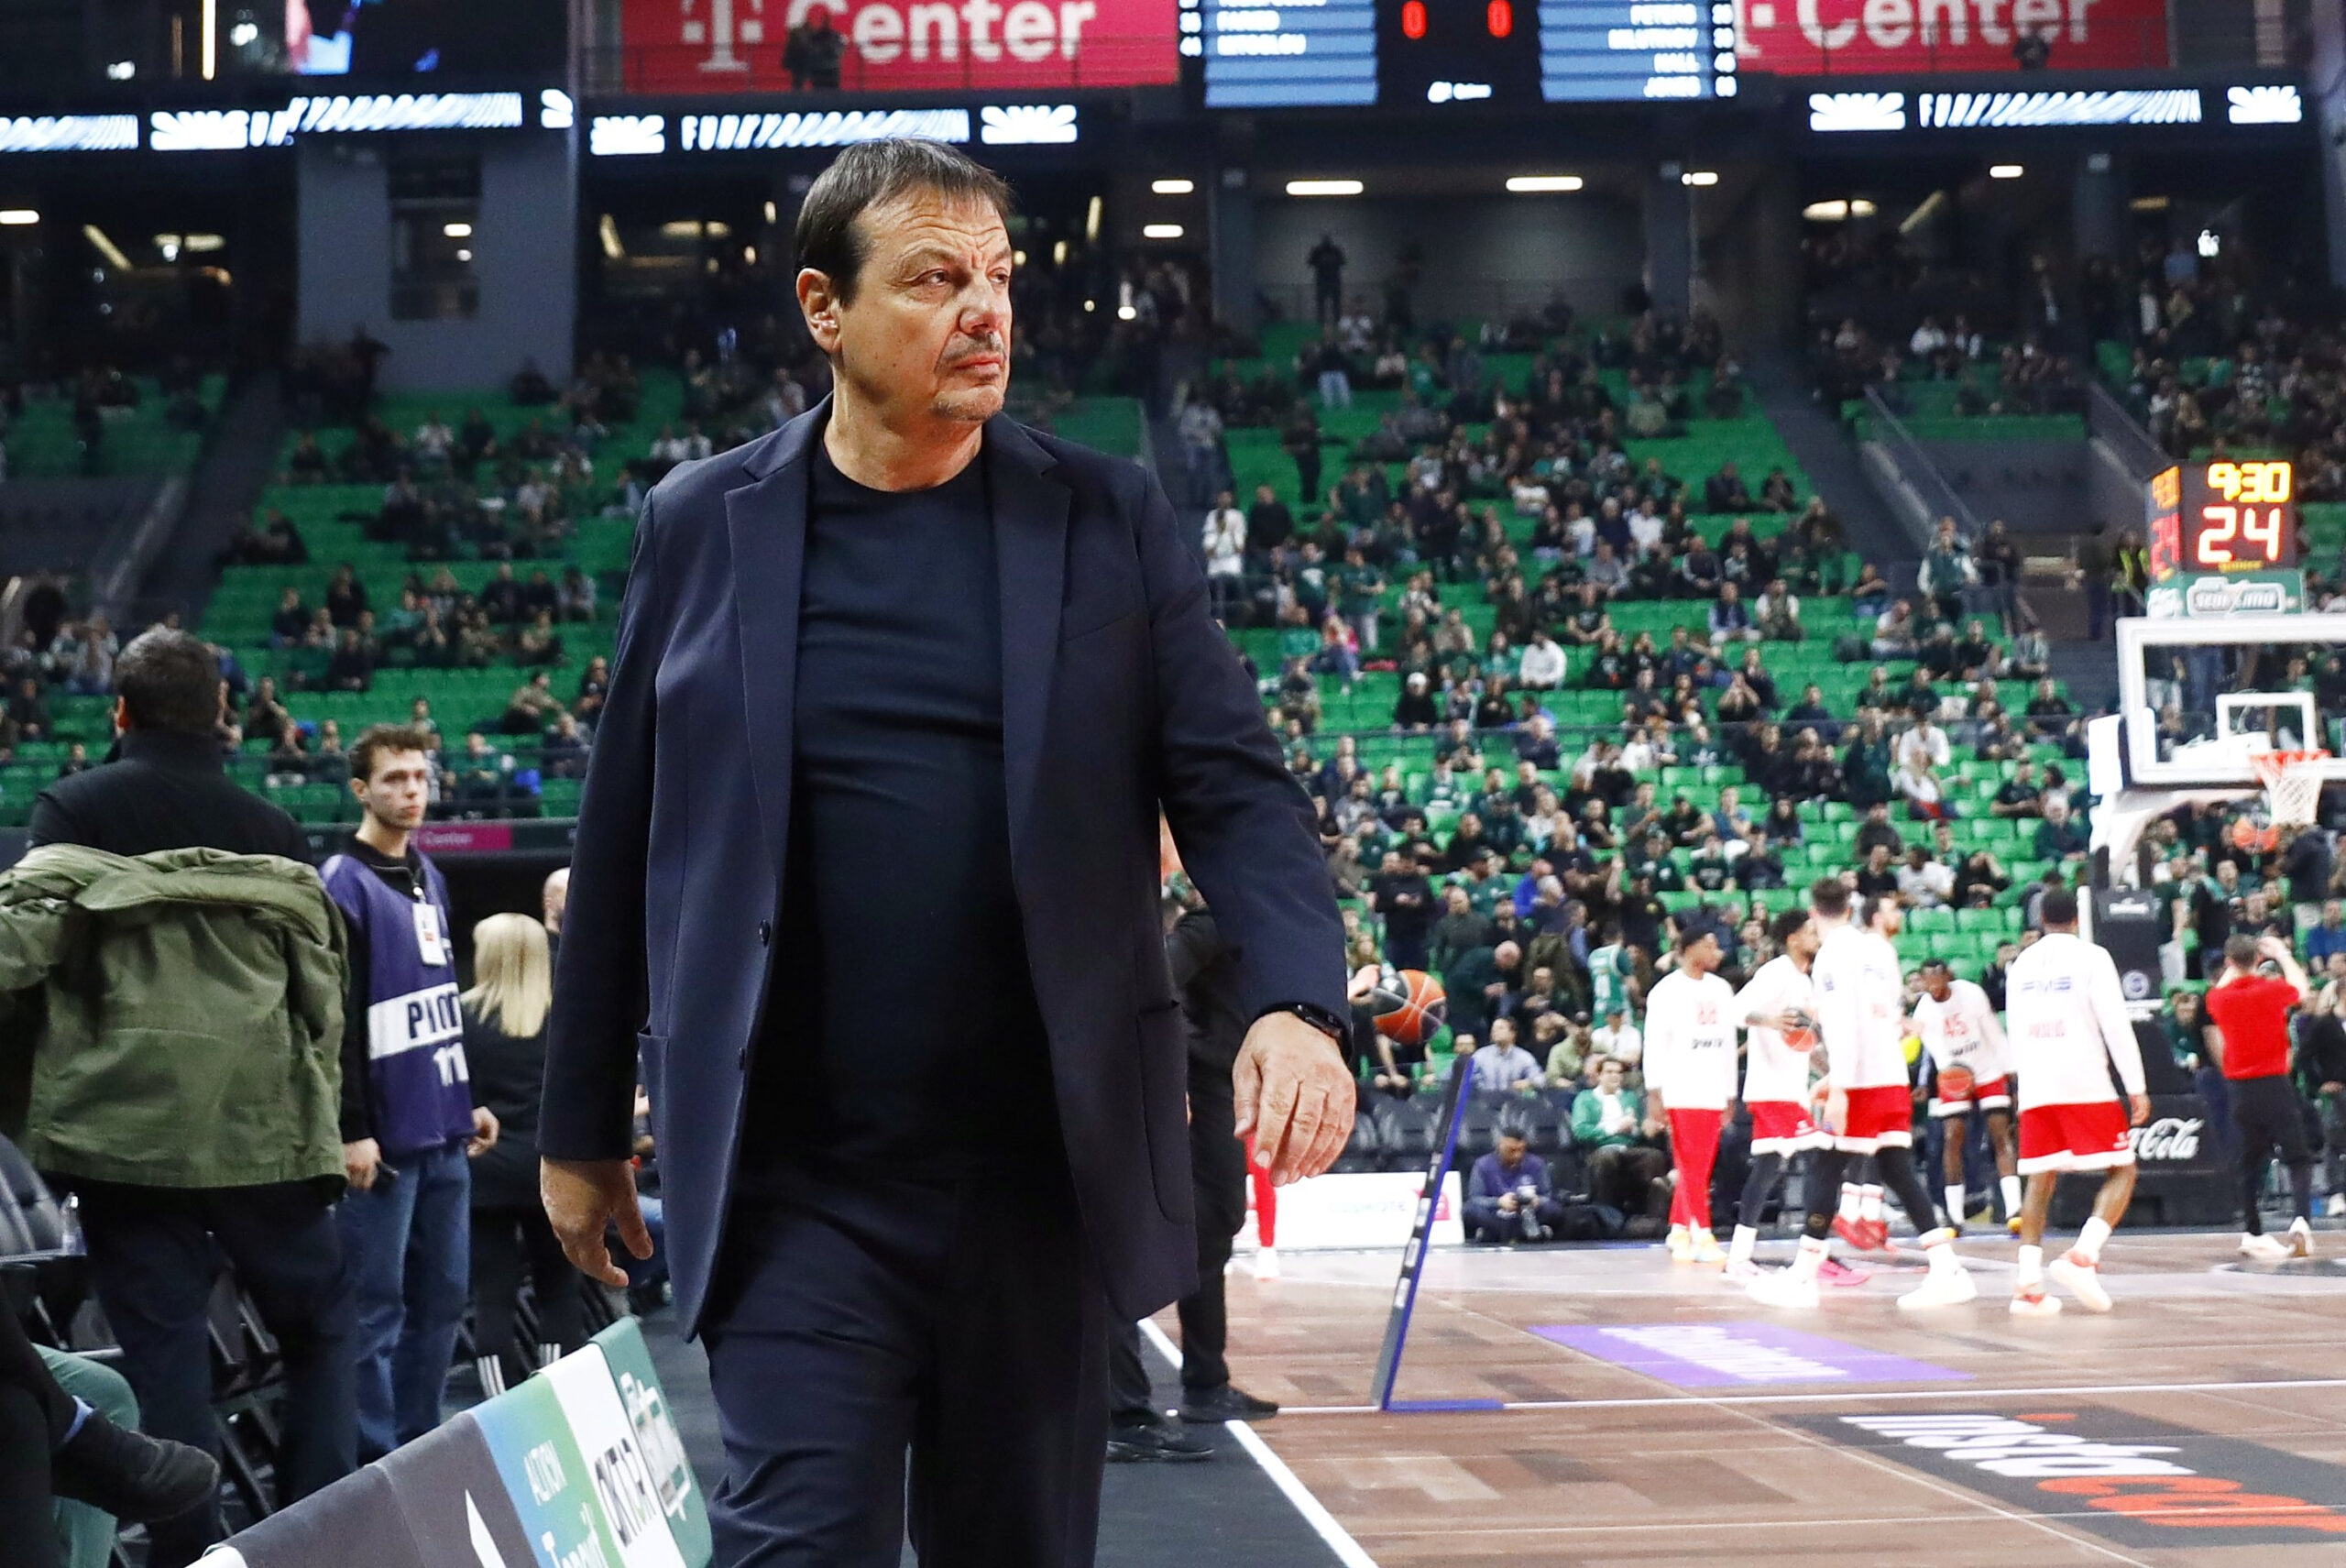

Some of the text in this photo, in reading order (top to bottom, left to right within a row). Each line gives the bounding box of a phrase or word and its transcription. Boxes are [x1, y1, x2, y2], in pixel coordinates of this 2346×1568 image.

[785, 0, 1096, 63] Center
[1401, 0, 1427, 39] 0
[1487, 0, 1513, 38] 0
[1796, 0, 2099, 49] Center
[2207, 461, 2292, 503] 9:30
[2197, 505, 2282, 565] 24
[1943, 1012, 1970, 1037] 45
[1836, 1411, 2346, 1534] instacar
